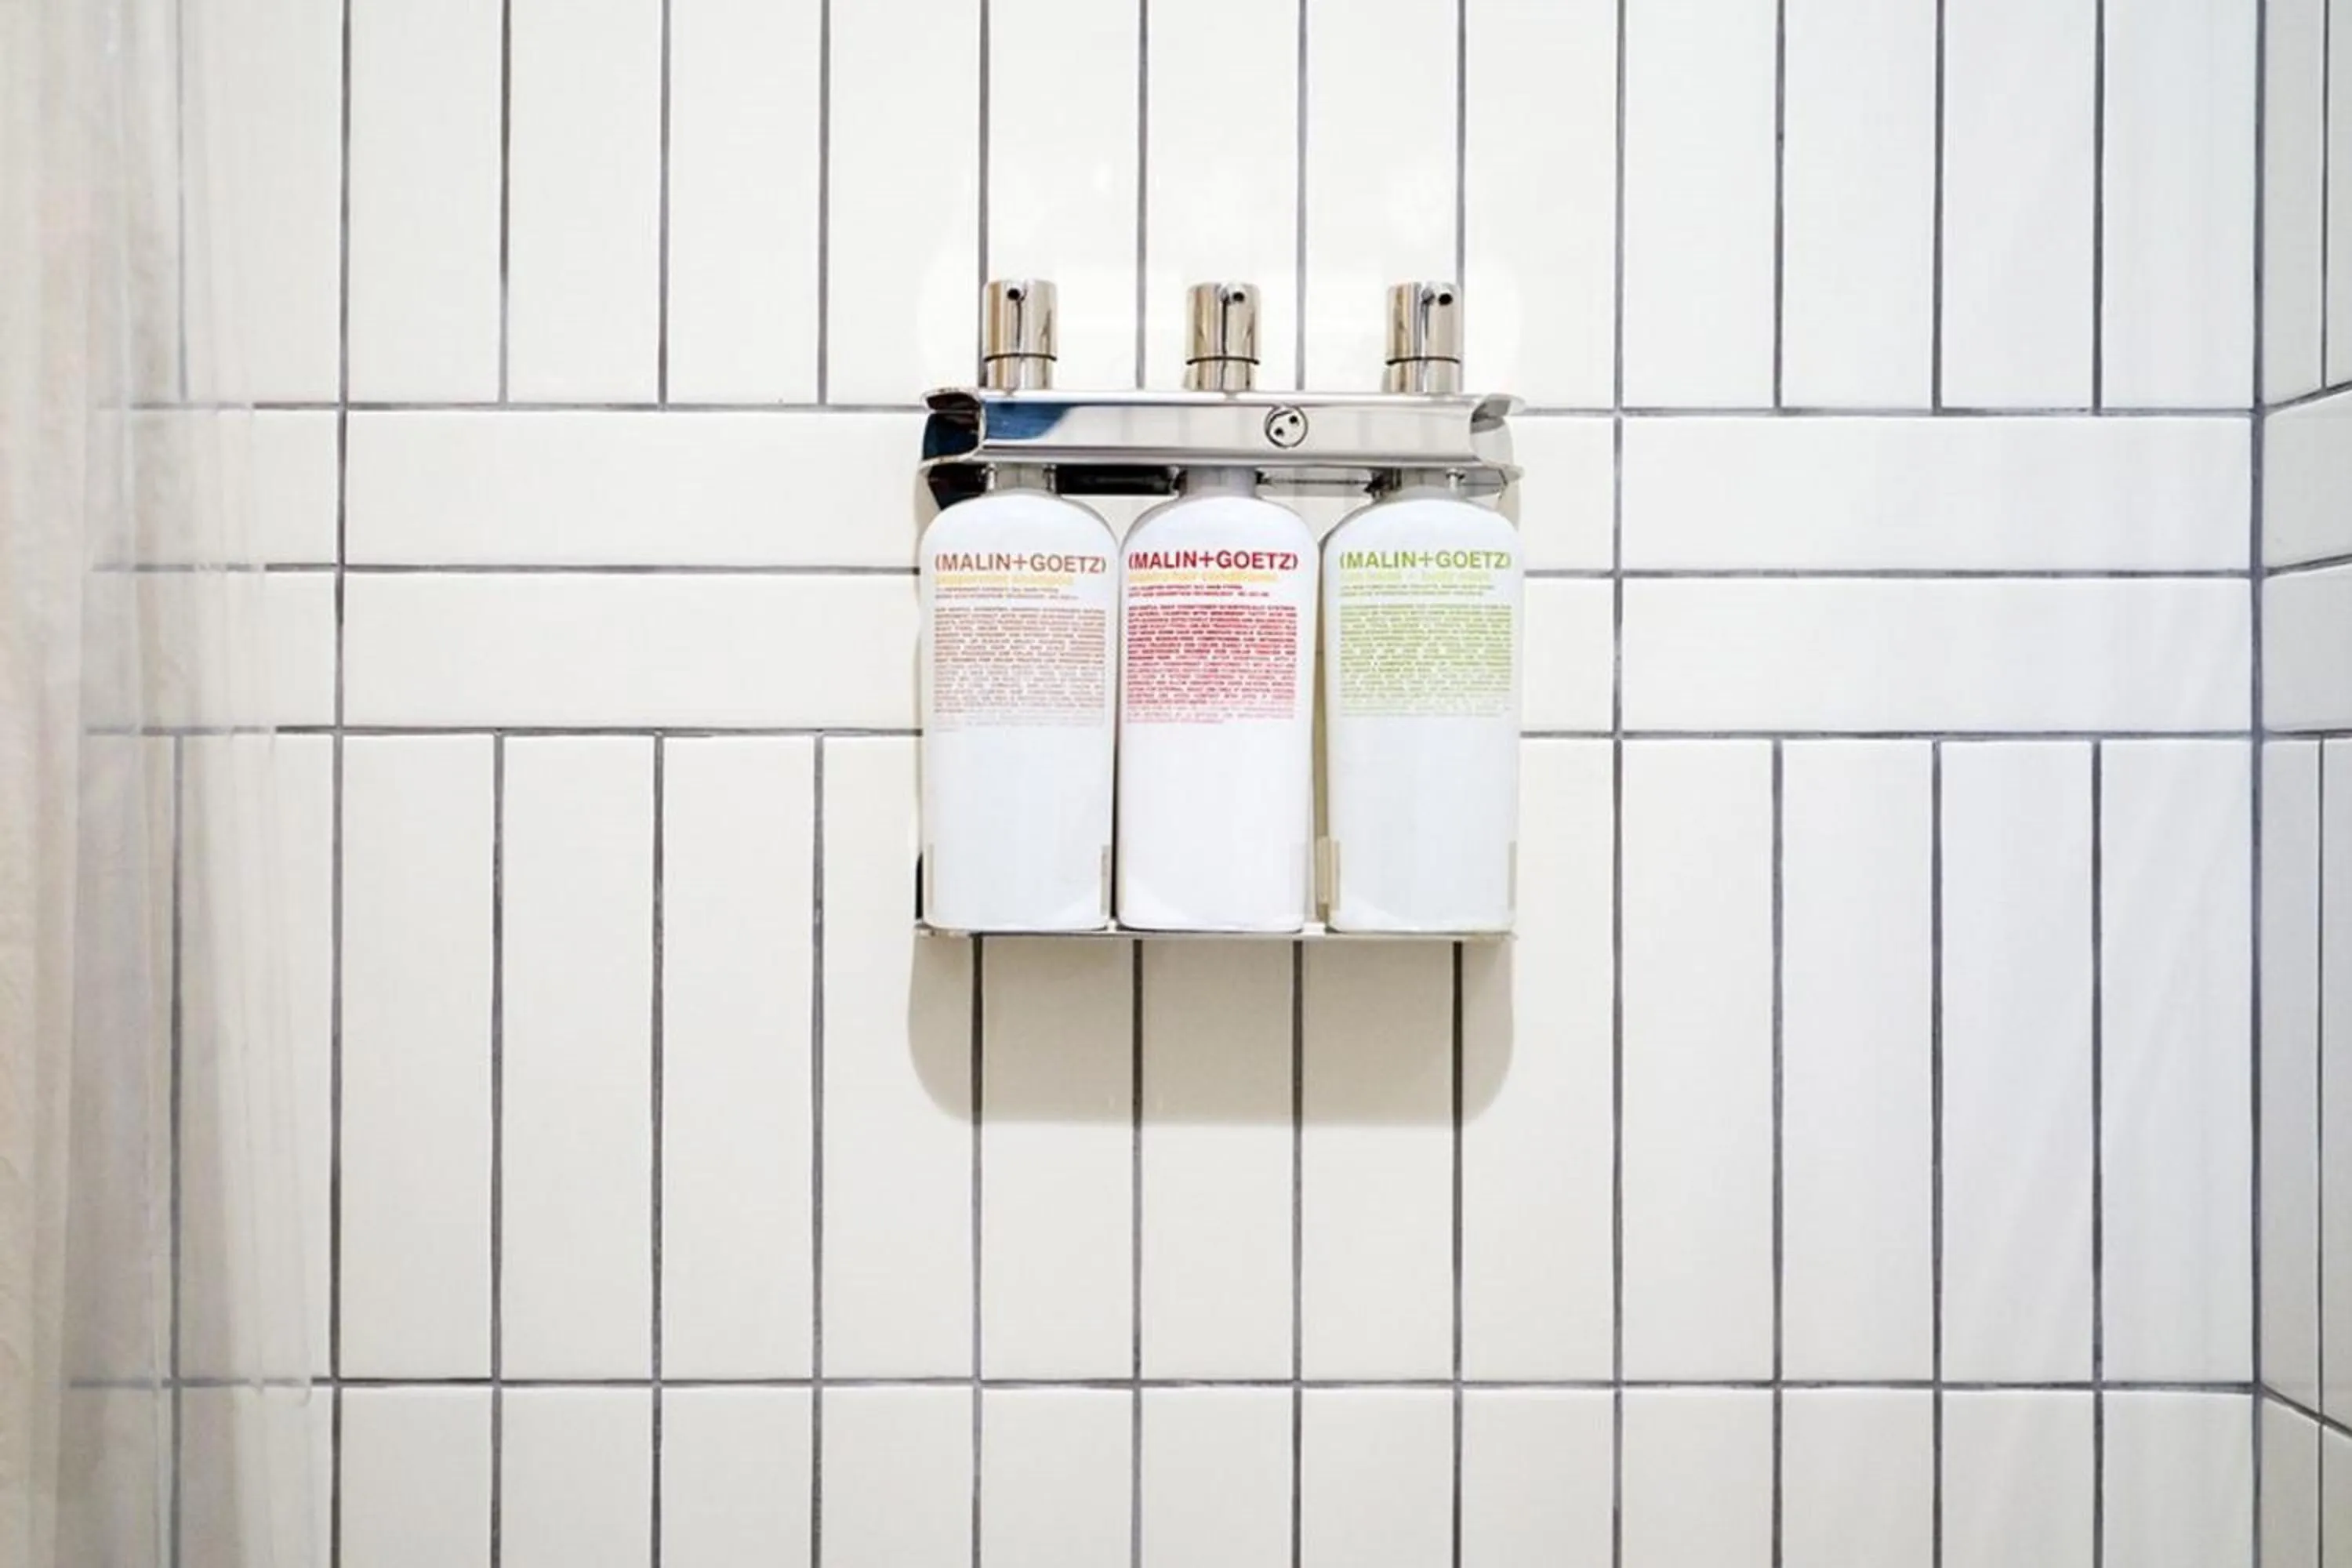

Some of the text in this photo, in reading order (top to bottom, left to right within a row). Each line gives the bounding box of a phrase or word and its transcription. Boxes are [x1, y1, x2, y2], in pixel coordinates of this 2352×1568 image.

[935, 553, 1107, 573] (MALIN+GOETZ)
[1128, 550, 1299, 570] (MALIN+GOETZ)
[1339, 550, 1512, 569] (MALIN+GOETZ)
